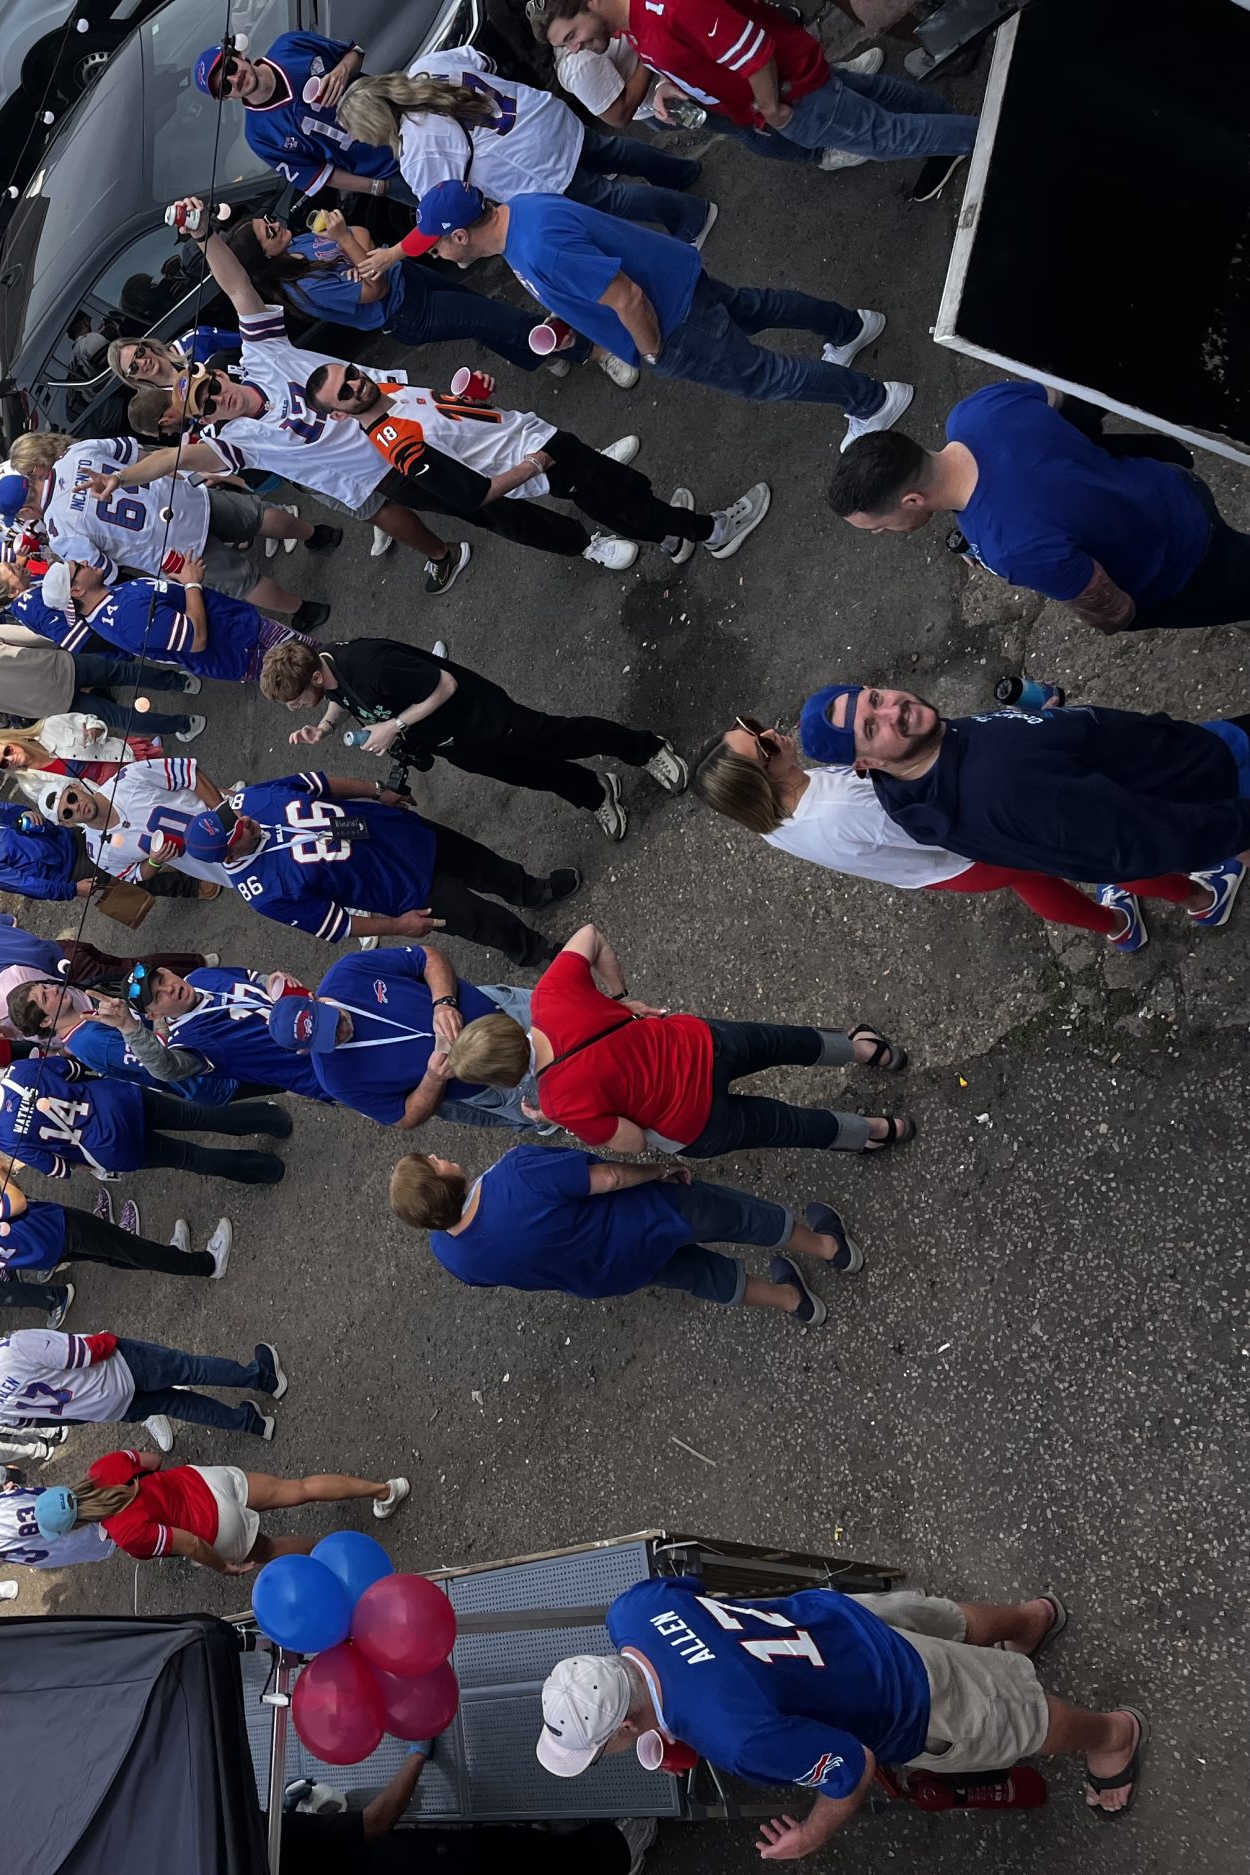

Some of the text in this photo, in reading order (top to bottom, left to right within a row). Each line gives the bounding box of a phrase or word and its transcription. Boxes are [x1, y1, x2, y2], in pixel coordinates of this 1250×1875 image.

[278, 381, 328, 445] 17
[280, 399, 289, 419] BILLS
[376, 426, 398, 448] 18
[17, 593, 34, 611] 14
[101, 604, 119, 627] 14
[284, 799, 352, 864] 86
[236, 875, 264, 902] 86
[38, 1096, 90, 1146] 14
[14, 1382, 73, 1416] 17
[649, 1610, 716, 1665] ALLEN
[694, 1595, 826, 1668] 17
